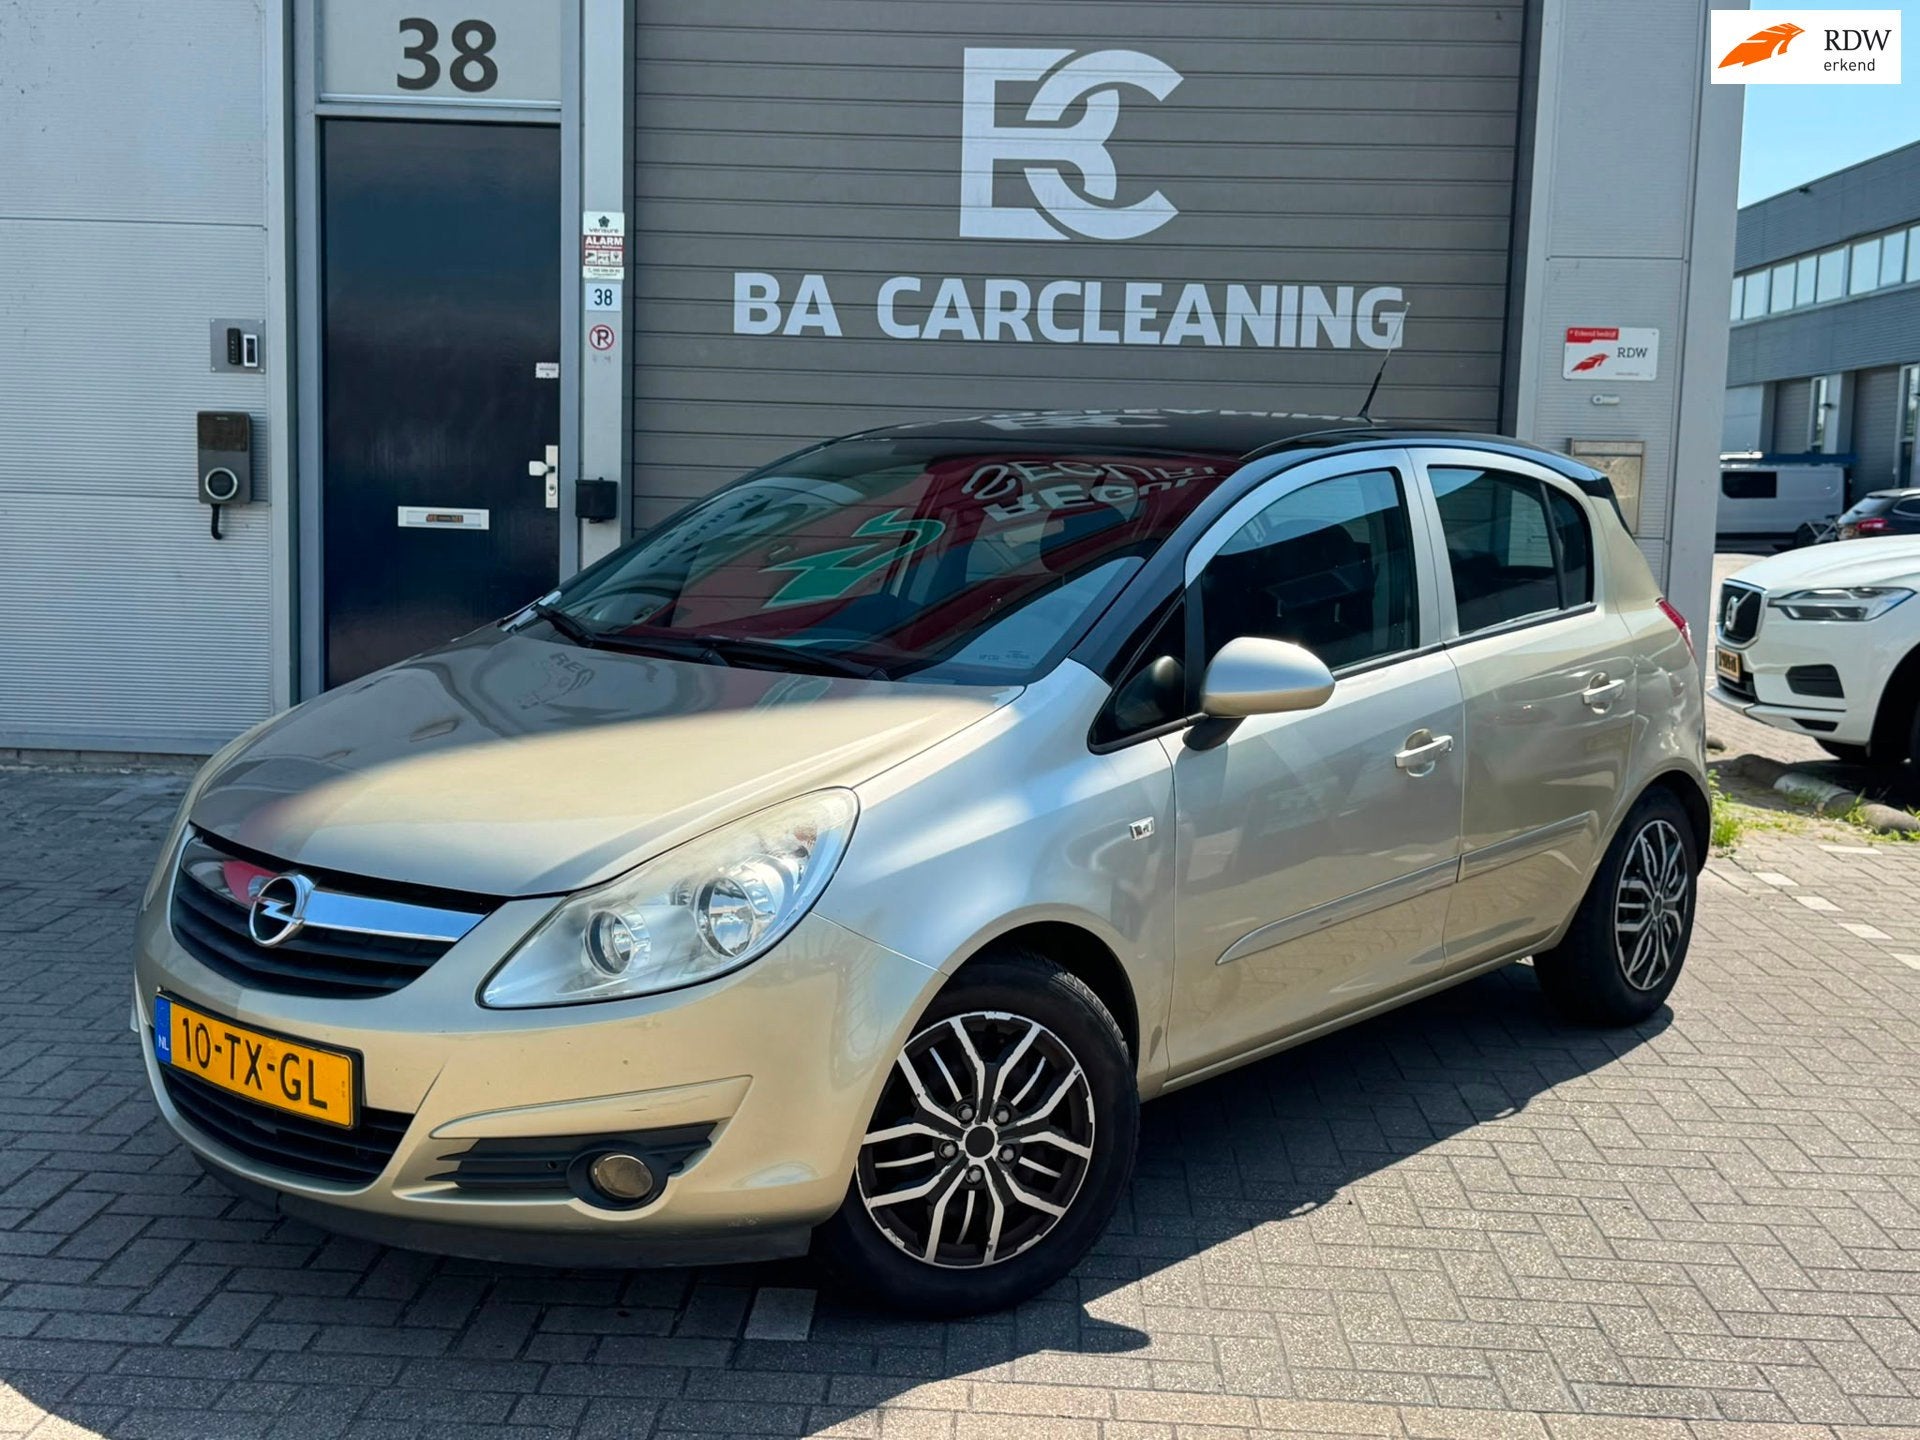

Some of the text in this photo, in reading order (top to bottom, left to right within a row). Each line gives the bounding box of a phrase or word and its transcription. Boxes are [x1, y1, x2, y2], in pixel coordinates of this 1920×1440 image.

[397, 17, 498, 93] 38
[585, 236, 623, 246] ALARM
[594, 288, 613, 306] 38
[733, 272, 1403, 349] BA CARCLEANING
[1617, 347, 1648, 358] RDW
[158, 1036, 169, 1051] NL
[182, 1017, 328, 1110] 10-TX-GL
